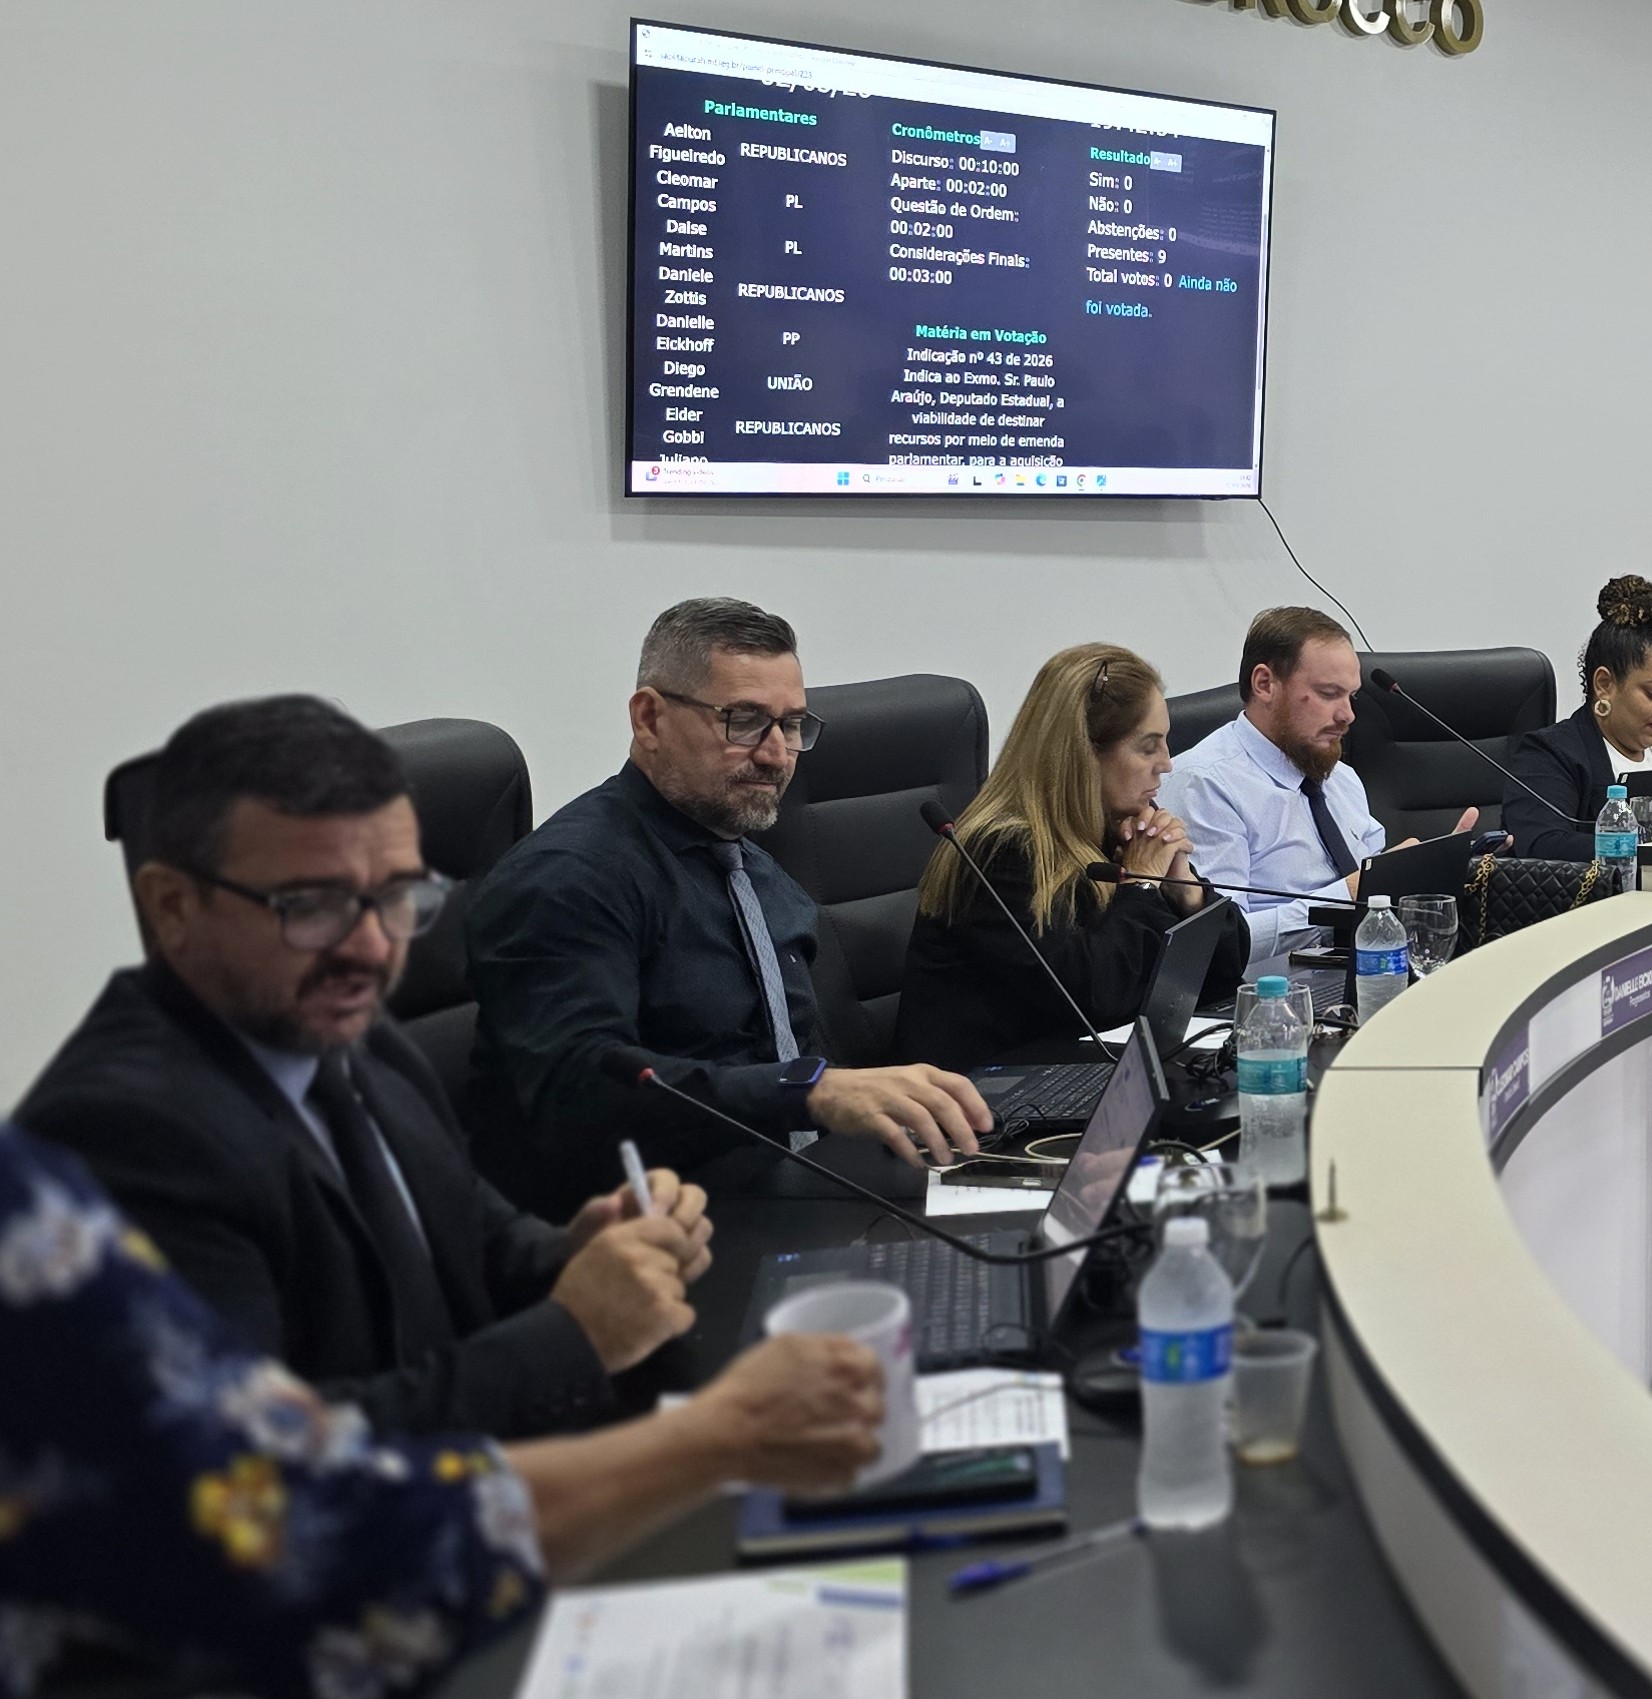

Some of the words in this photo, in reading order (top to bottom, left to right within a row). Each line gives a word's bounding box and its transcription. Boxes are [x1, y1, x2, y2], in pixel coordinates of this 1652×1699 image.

[704, 100, 818, 126] Parlamentares
[891, 123, 980, 145] Cronômetros
[650, 145, 726, 165] Figueiredo
[740, 143, 847, 166] REPUBLICANOS
[891, 149, 954, 170] Discurso:
[958, 156, 1020, 176] 00:10:00
[1090, 146, 1151, 166] Resultado
[656, 170, 718, 189] Cleomar
[890, 172, 941, 192] Aparte:
[946, 178, 1008, 198] 00:02:00
[1089, 171, 1120, 190] Sim:
[1123, 175, 1134, 191] 0
[657, 194, 717, 213] Campos
[785, 194, 804, 208] PL
[890, 196, 947, 215] Questão
[950, 202, 967, 217] de
[970, 204, 1020, 223] Ordem:
[1089, 195, 1120, 213] Não:
[1123, 199, 1133, 214] 0
[666, 219, 708, 236] Daise
[890, 220, 954, 238] 00:02:00
[1087, 219, 1165, 241] Abstenções:
[1168, 227, 1178, 242] 0
[659, 242, 714, 259] Martins
[785, 240, 803, 255] PL
[889, 243, 985, 266] Considerações
[988, 252, 1030, 269] Finais:
[1087, 243, 1154, 263] Presentes:
[1157, 249, 1168, 264] 9
[658, 266, 714, 283] Daniele
[889, 266, 953, 285] 00:03:00
[1086, 266, 1118, 283] Total
[1120, 272, 1160, 287] votos:
[1163, 273, 1173, 288] 0
[1178, 274, 1212, 291] Ainda
[1215, 277, 1238, 293] não
[664, 290, 708, 306] Zottis
[738, 283, 845, 303] REPUBLICANOS
[1085, 300, 1102, 315] foi
[1105, 302, 1153, 318] votada.
[656, 313, 715, 330] Danielle
[656, 336, 716, 352] Eickhoff
[782, 331, 800, 345] PP
[915, 324, 967, 340] Matéria
[970, 329, 991, 341] em
[995, 328, 1047, 346] Votação
[906, 347, 966, 366] Indicação
[968, 351, 985, 364] nº
[986, 352, 1002, 365] 43
[1005, 352, 1021, 366] de
[1023, 353, 1054, 367] 2026
[664, 360, 706, 378] Diego
[903, 368, 942, 384] Indica
[945, 373, 961, 384] ao
[964, 371, 1001, 386] Exmo.
[1004, 373, 1021, 387] Sr.
[1023, 374, 1056, 388] Paulo
[649, 382, 720, 399] Grendene
[767, 374, 813, 391] UNIÃO
[890, 388, 937, 406] Araújo,
[940, 391, 998, 407] Deputado
[1001, 393, 1054, 410] Estadual,
[1056, 397, 1065, 408] a
[665, 407, 703, 422] Elder
[911, 411, 977, 425] viabilidade
[979, 412, 995, 427] de
[997, 413, 1046, 428] destinar
[663, 429, 705, 445] Gobbi
[735, 420, 842, 437] REPUBLICANOS
[888, 433, 941, 446] recursos
[944, 434, 965, 448] por
[968, 434, 998, 447] meio
[1000, 434, 1016, 448] de
[1018, 435, 1065, 449] emenda
[969, 455, 995, 467] para
[999, 457, 1006, 467] a
